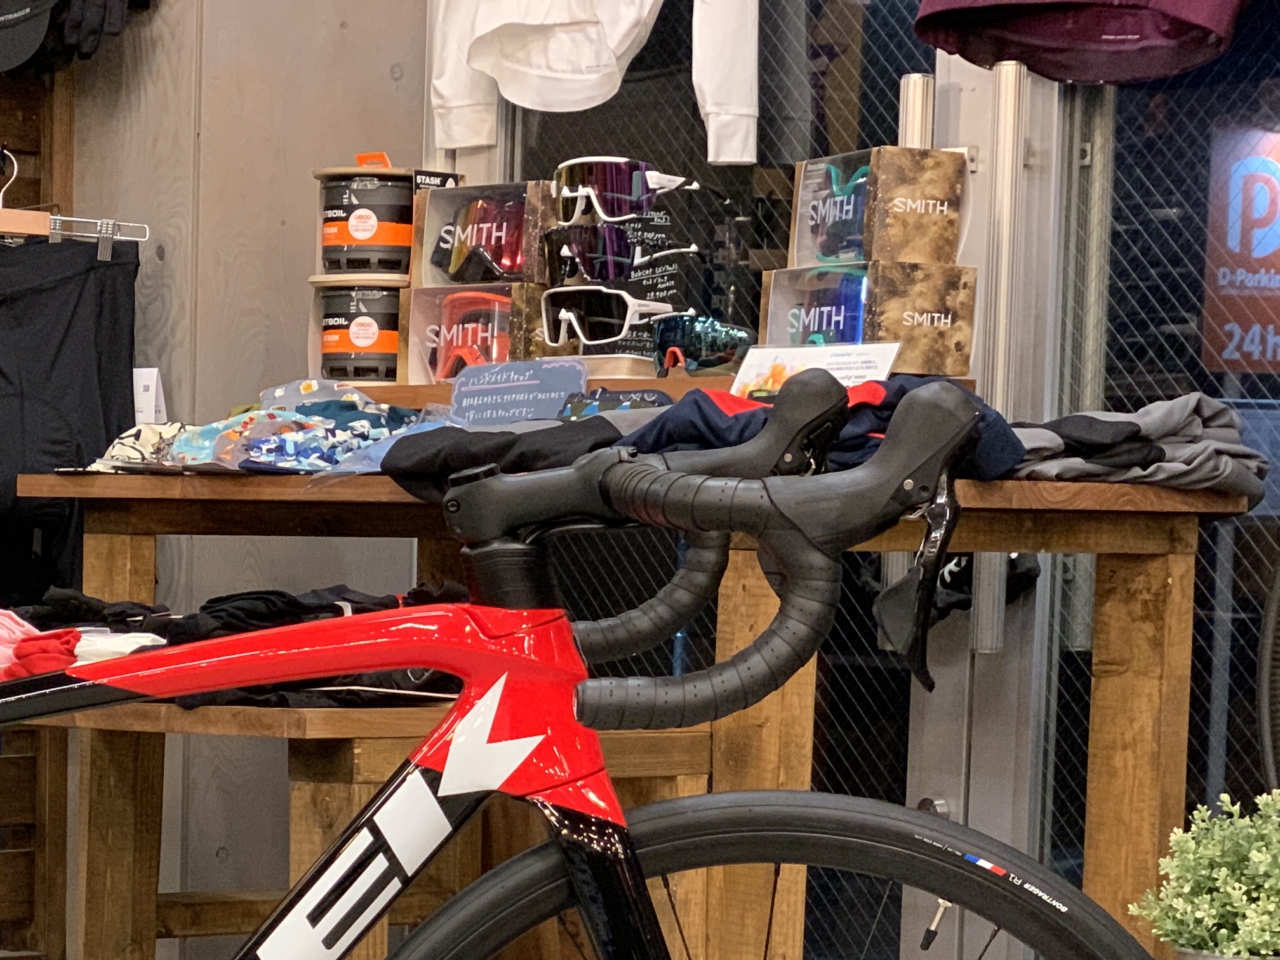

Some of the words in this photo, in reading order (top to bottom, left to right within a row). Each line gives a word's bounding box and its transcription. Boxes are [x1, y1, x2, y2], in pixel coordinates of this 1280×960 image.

[416, 175, 441, 186] STASH
[808, 194, 855, 226] SMITH
[893, 197, 948, 216] SMITH
[440, 222, 507, 250] SMITH
[787, 305, 845, 333] SMITH
[902, 311, 952, 328] SMITH
[425, 323, 492, 348] SMITH
[1008, 872, 1023, 886] R1
[1023, 882, 1069, 913] BONTRAGER
